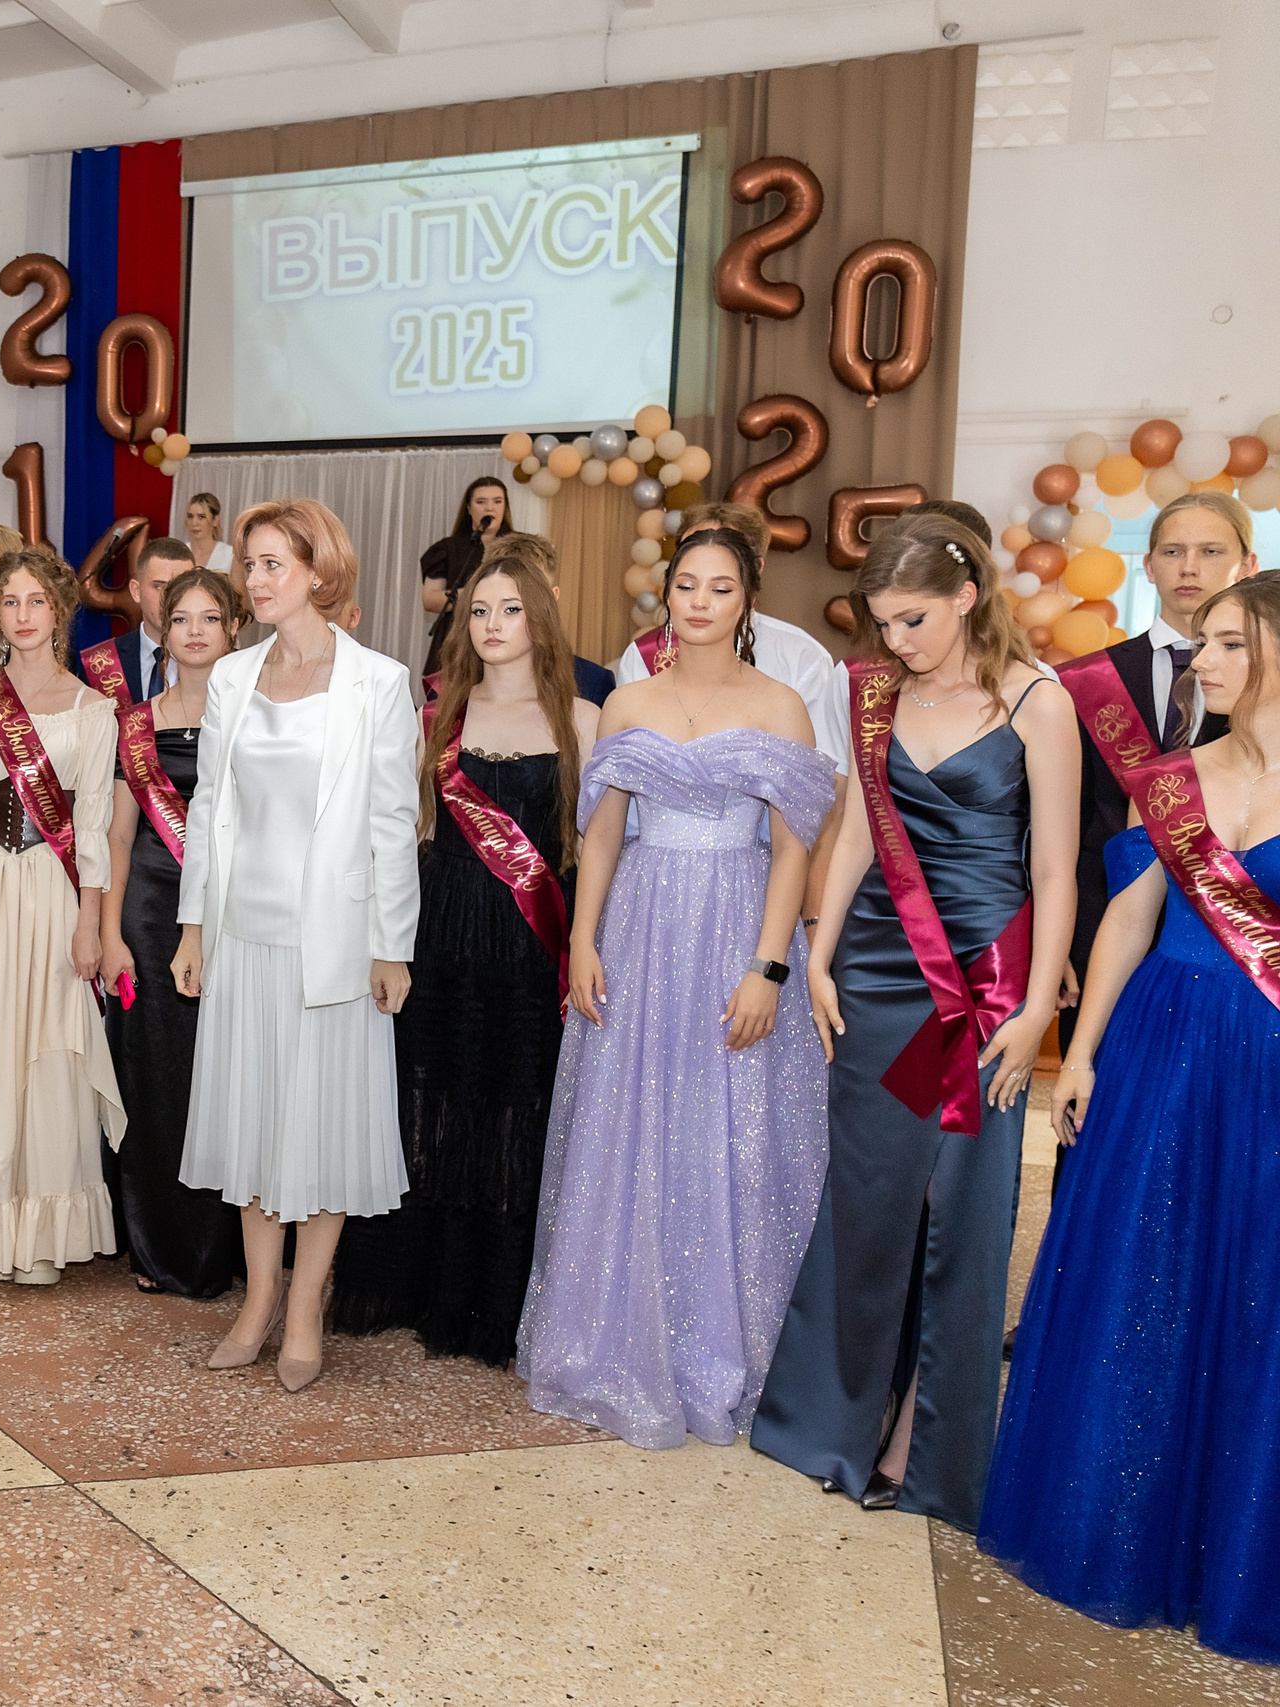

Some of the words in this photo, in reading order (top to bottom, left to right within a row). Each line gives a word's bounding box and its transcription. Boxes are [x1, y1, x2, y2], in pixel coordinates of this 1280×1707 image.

[264, 178, 679, 295] ВЫПУСК
[393, 303, 530, 391] 2025
[1, 717, 61, 829] Выпускница
[1166, 812, 1280, 970] Выпускница
[1207, 843, 1242, 891] Силкина
